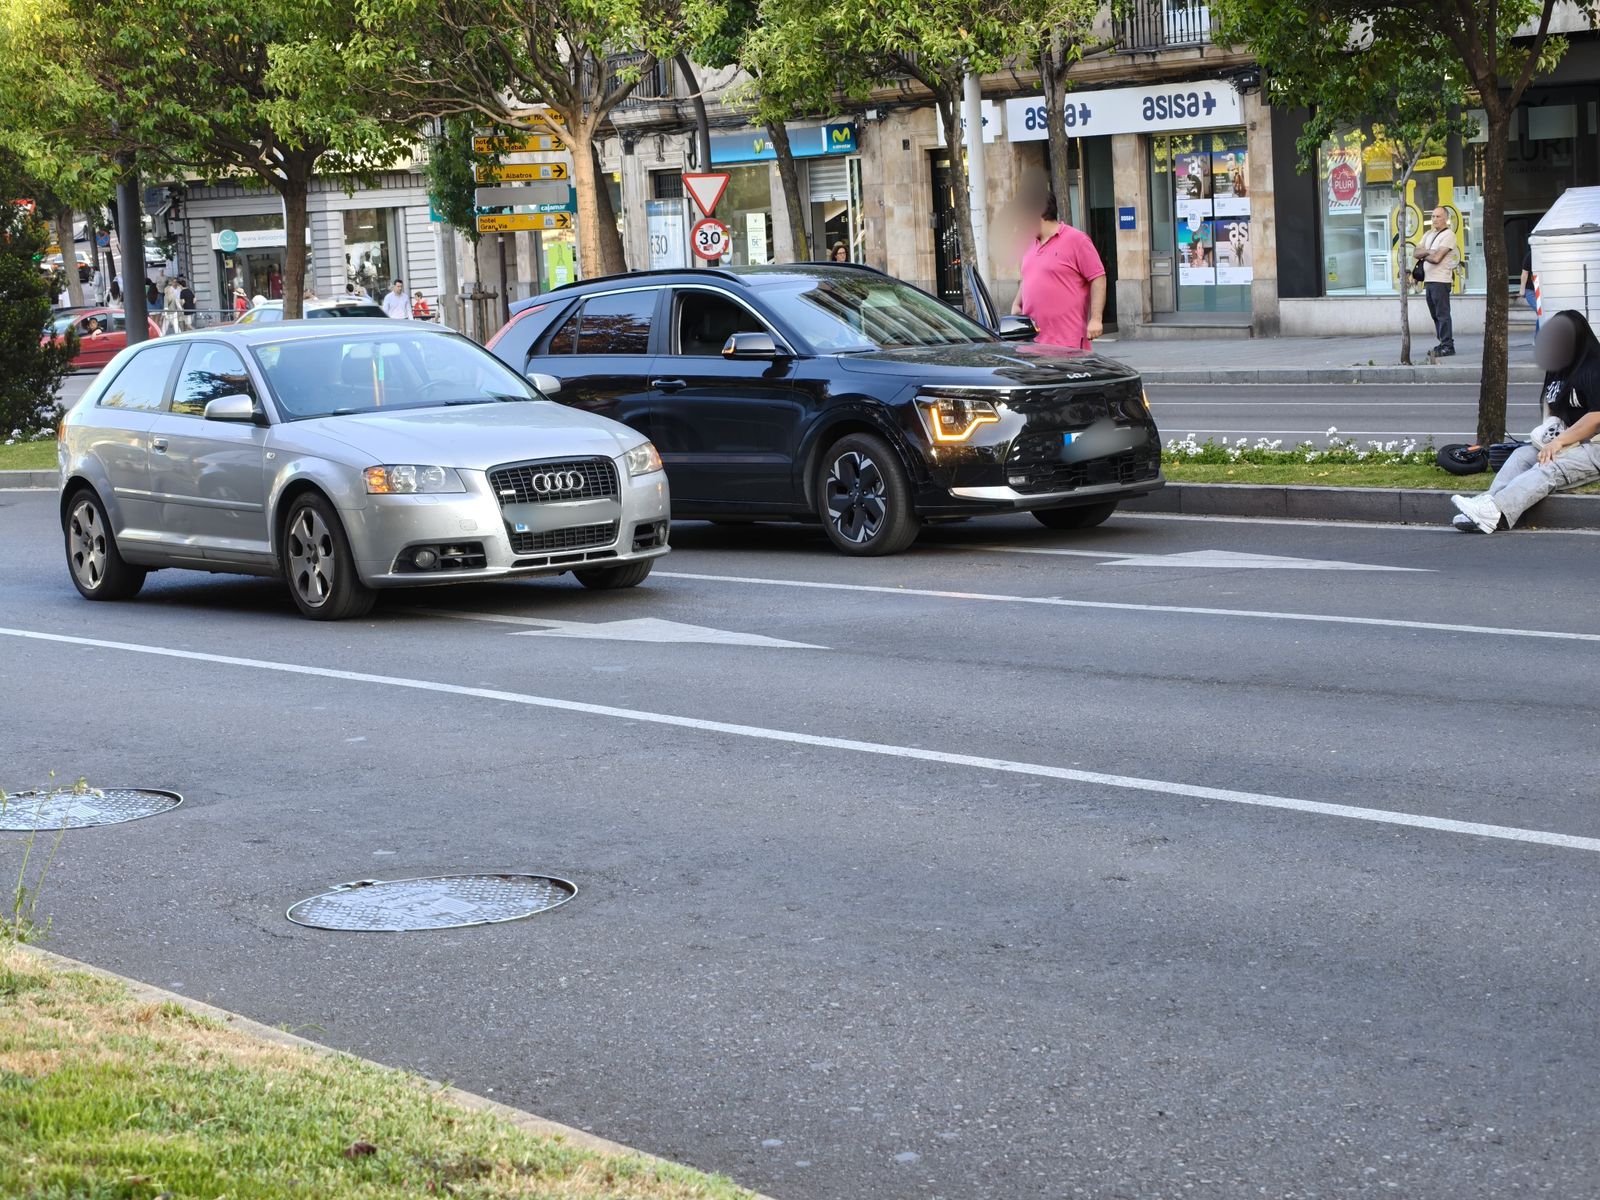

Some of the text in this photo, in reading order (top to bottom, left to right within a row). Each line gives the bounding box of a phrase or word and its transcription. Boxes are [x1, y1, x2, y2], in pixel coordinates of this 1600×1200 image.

[1025, 103, 1077, 130] asa
[1143, 92, 1200, 121] asisa
[1334, 180, 1355, 190] PLURI
[699, 231, 721, 245] 30
